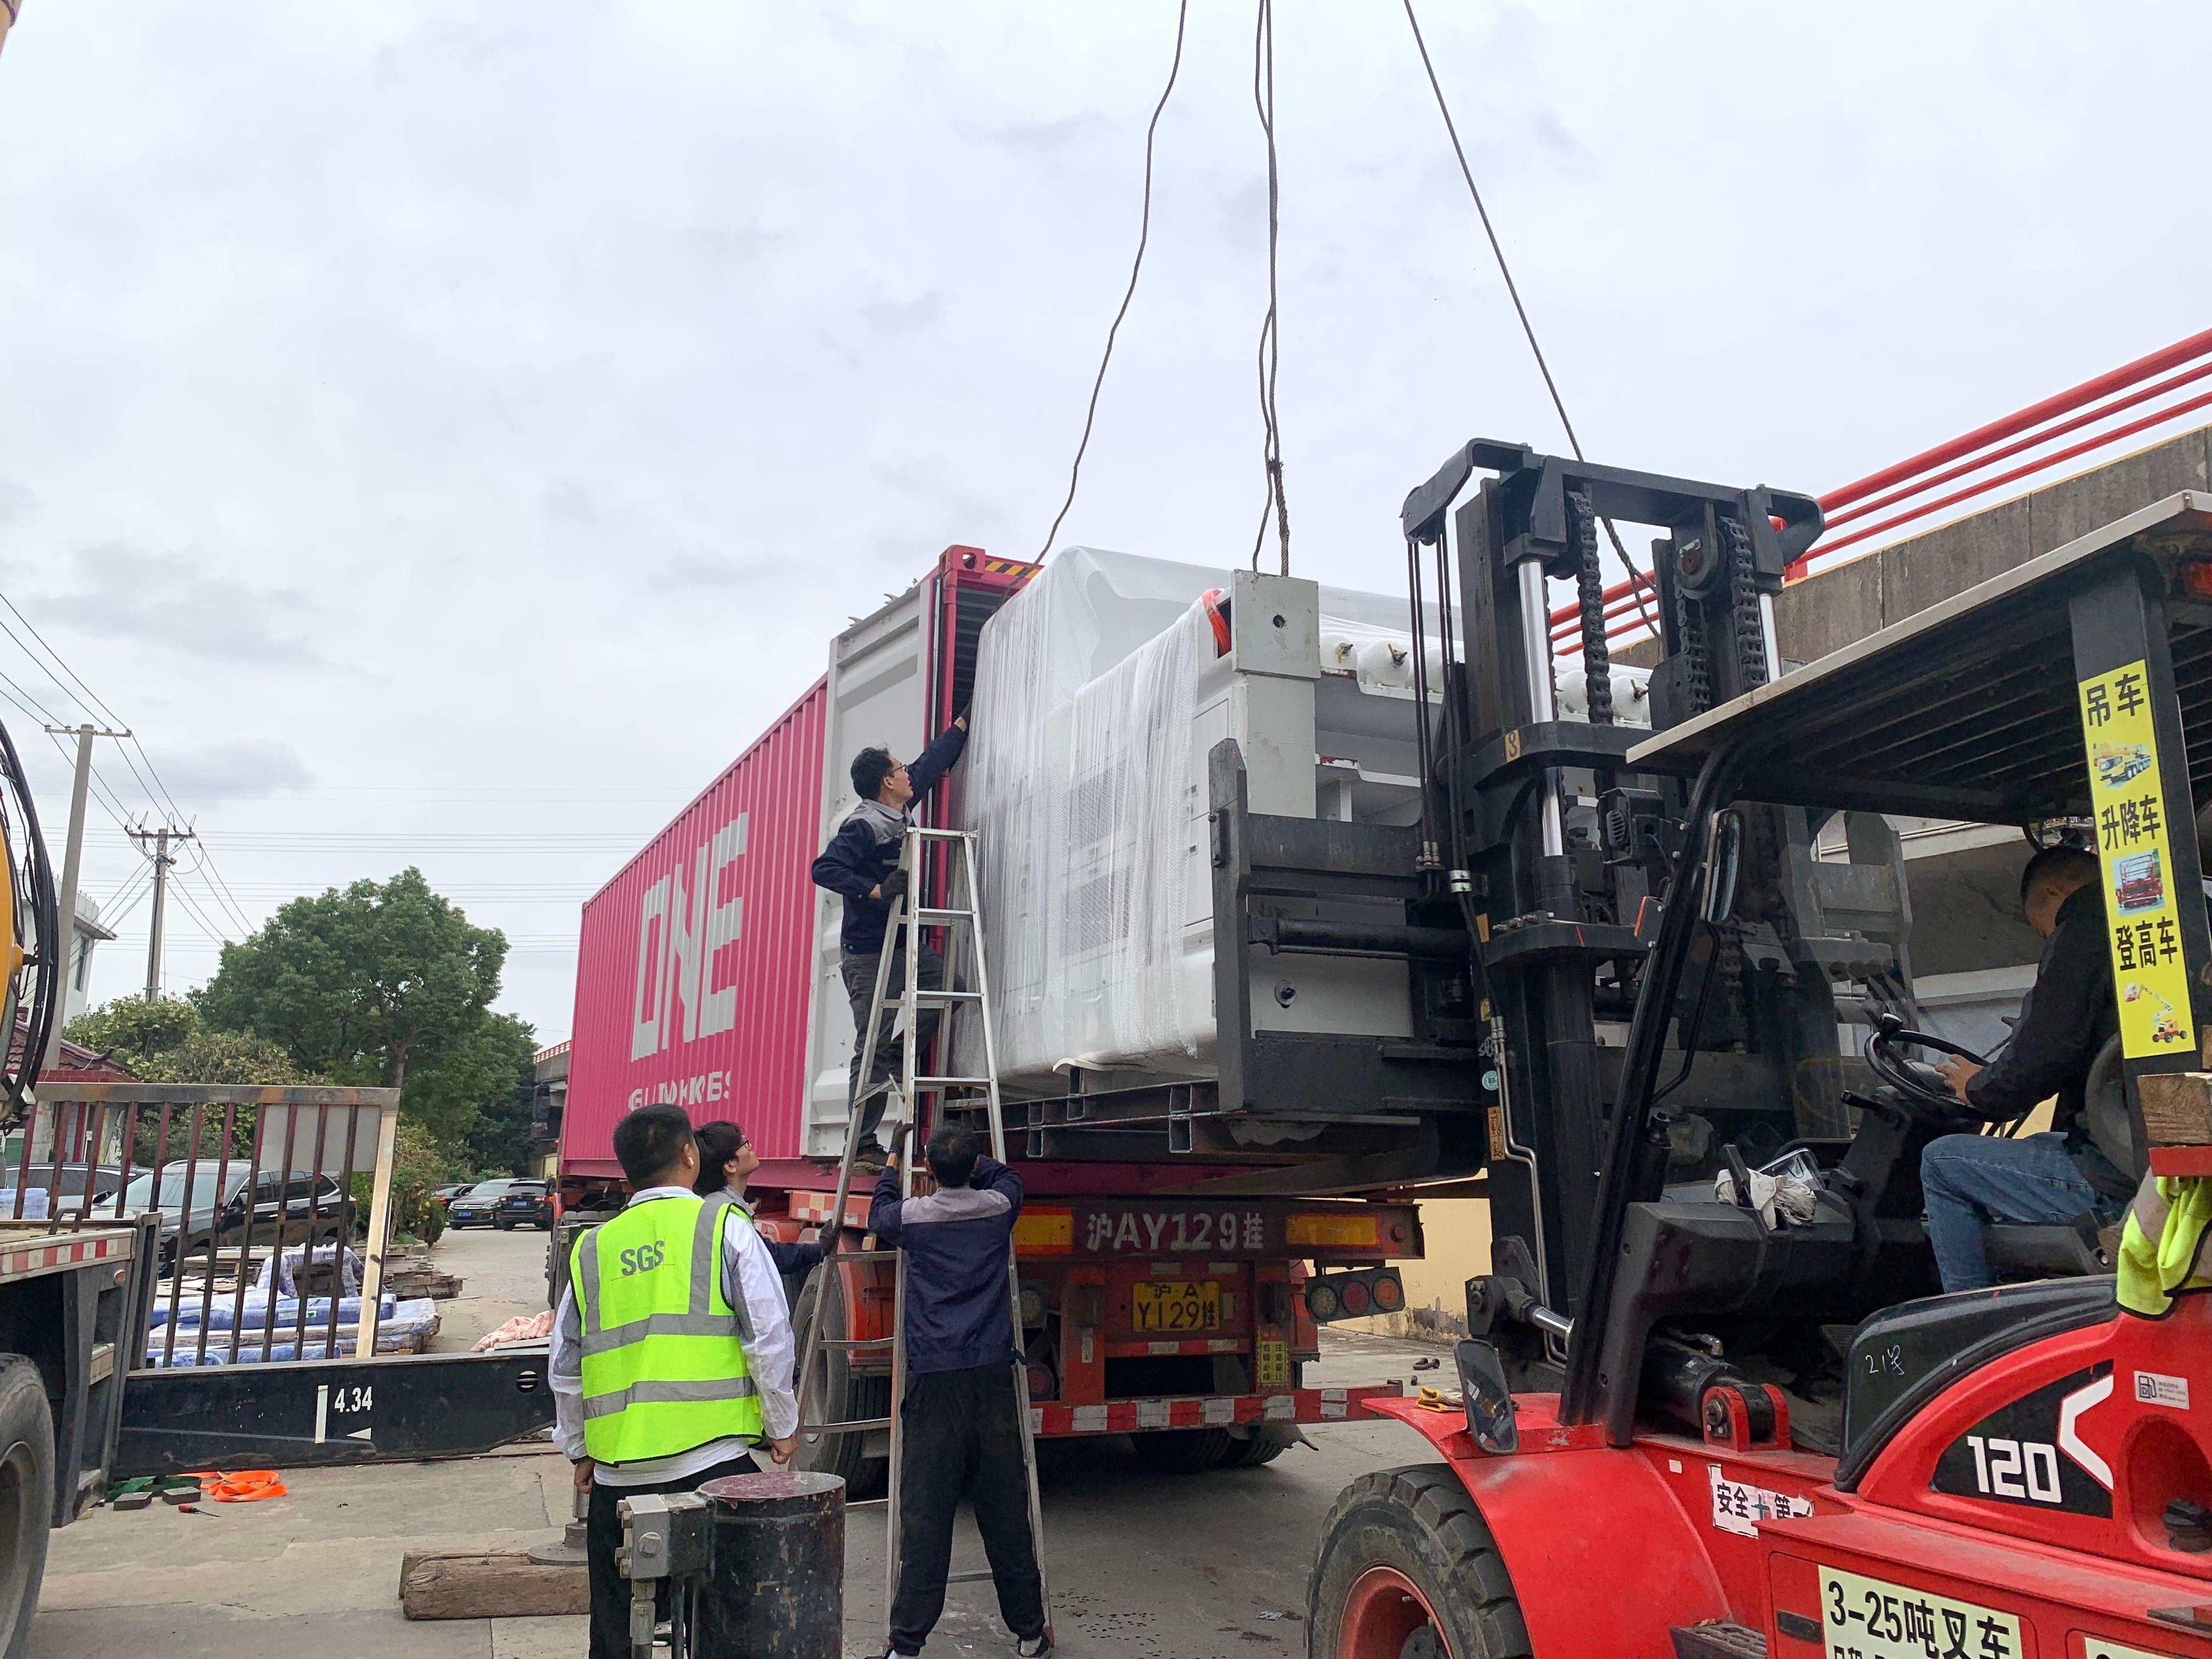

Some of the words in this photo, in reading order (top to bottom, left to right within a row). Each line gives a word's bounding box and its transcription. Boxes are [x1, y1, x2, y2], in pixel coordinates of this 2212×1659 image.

[2086, 674, 2144, 727] 吊车
[2102, 794, 2161, 850] 升降车
[631, 812, 748, 1062] ONE
[2116, 916, 2177, 971] 登高车
[620, 1240, 665, 1277] SGS
[1086, 1212, 1263, 1251] 沪AY129挂
[334, 1386, 373, 1413] 4.34
[1967, 1435, 2062, 1503] 120
[1828, 1581, 2010, 1659] 3-25吨叉车
